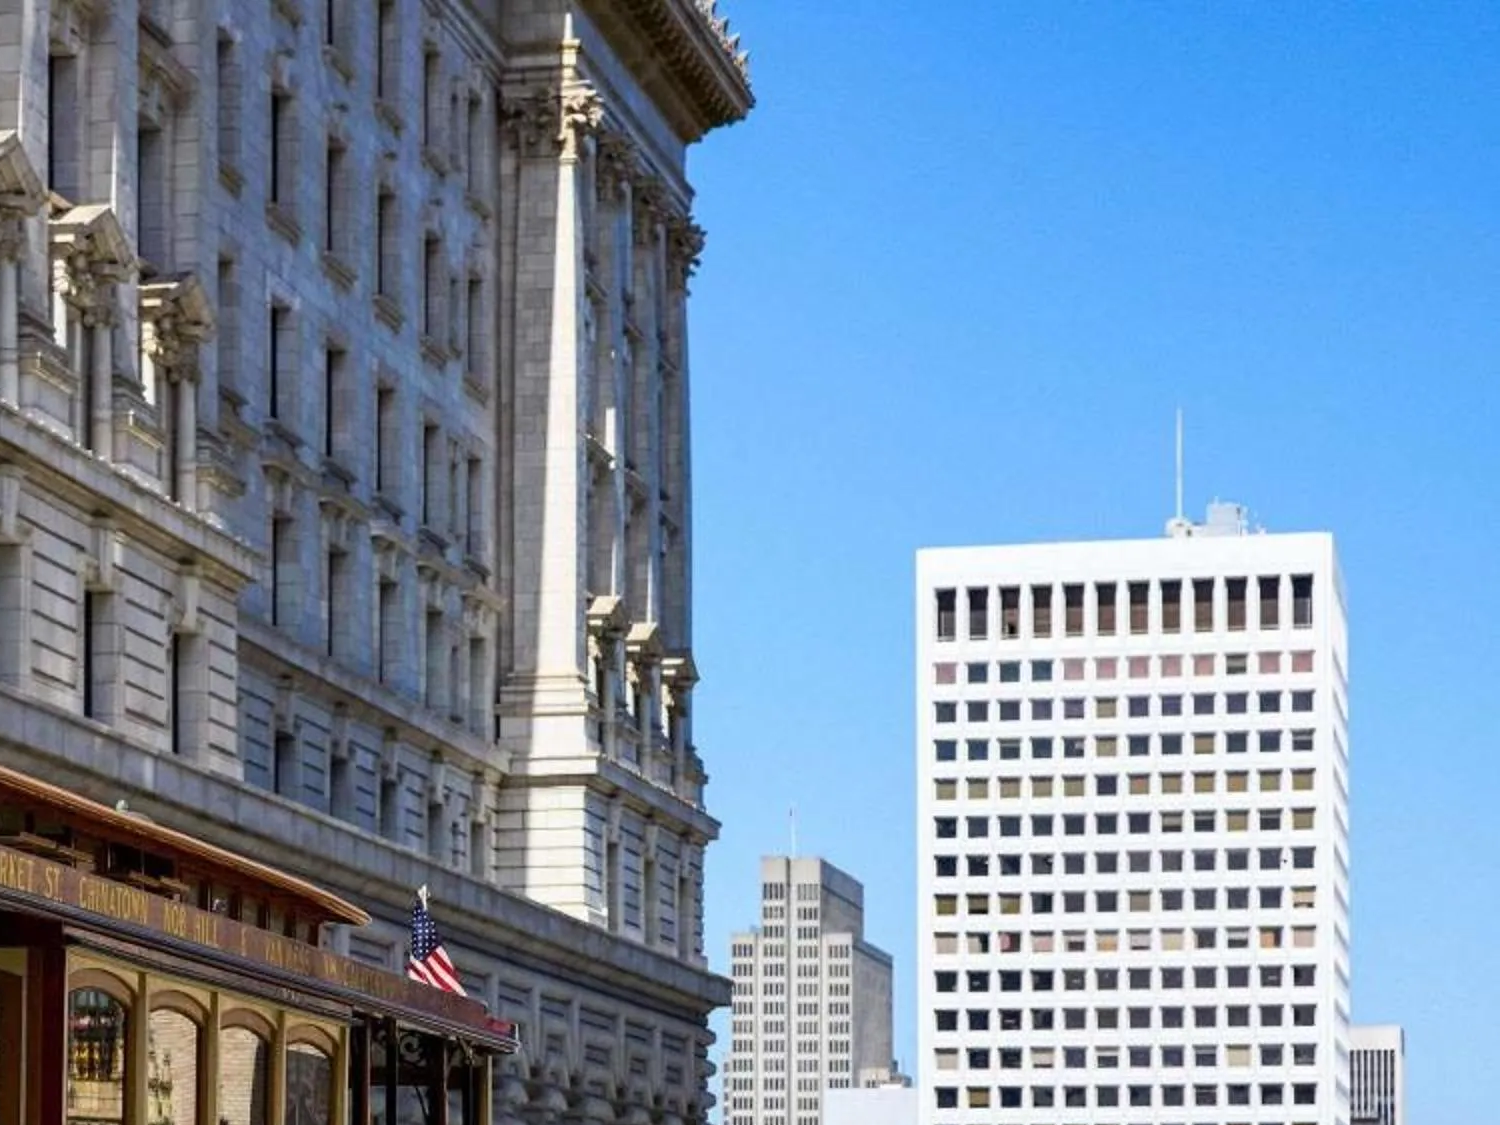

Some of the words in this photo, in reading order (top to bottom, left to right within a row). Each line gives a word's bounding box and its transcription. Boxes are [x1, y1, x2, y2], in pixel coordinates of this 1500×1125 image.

[79, 876, 149, 925] CHINATOWN
[164, 901, 186, 937] NOB
[193, 914, 218, 949] HILL
